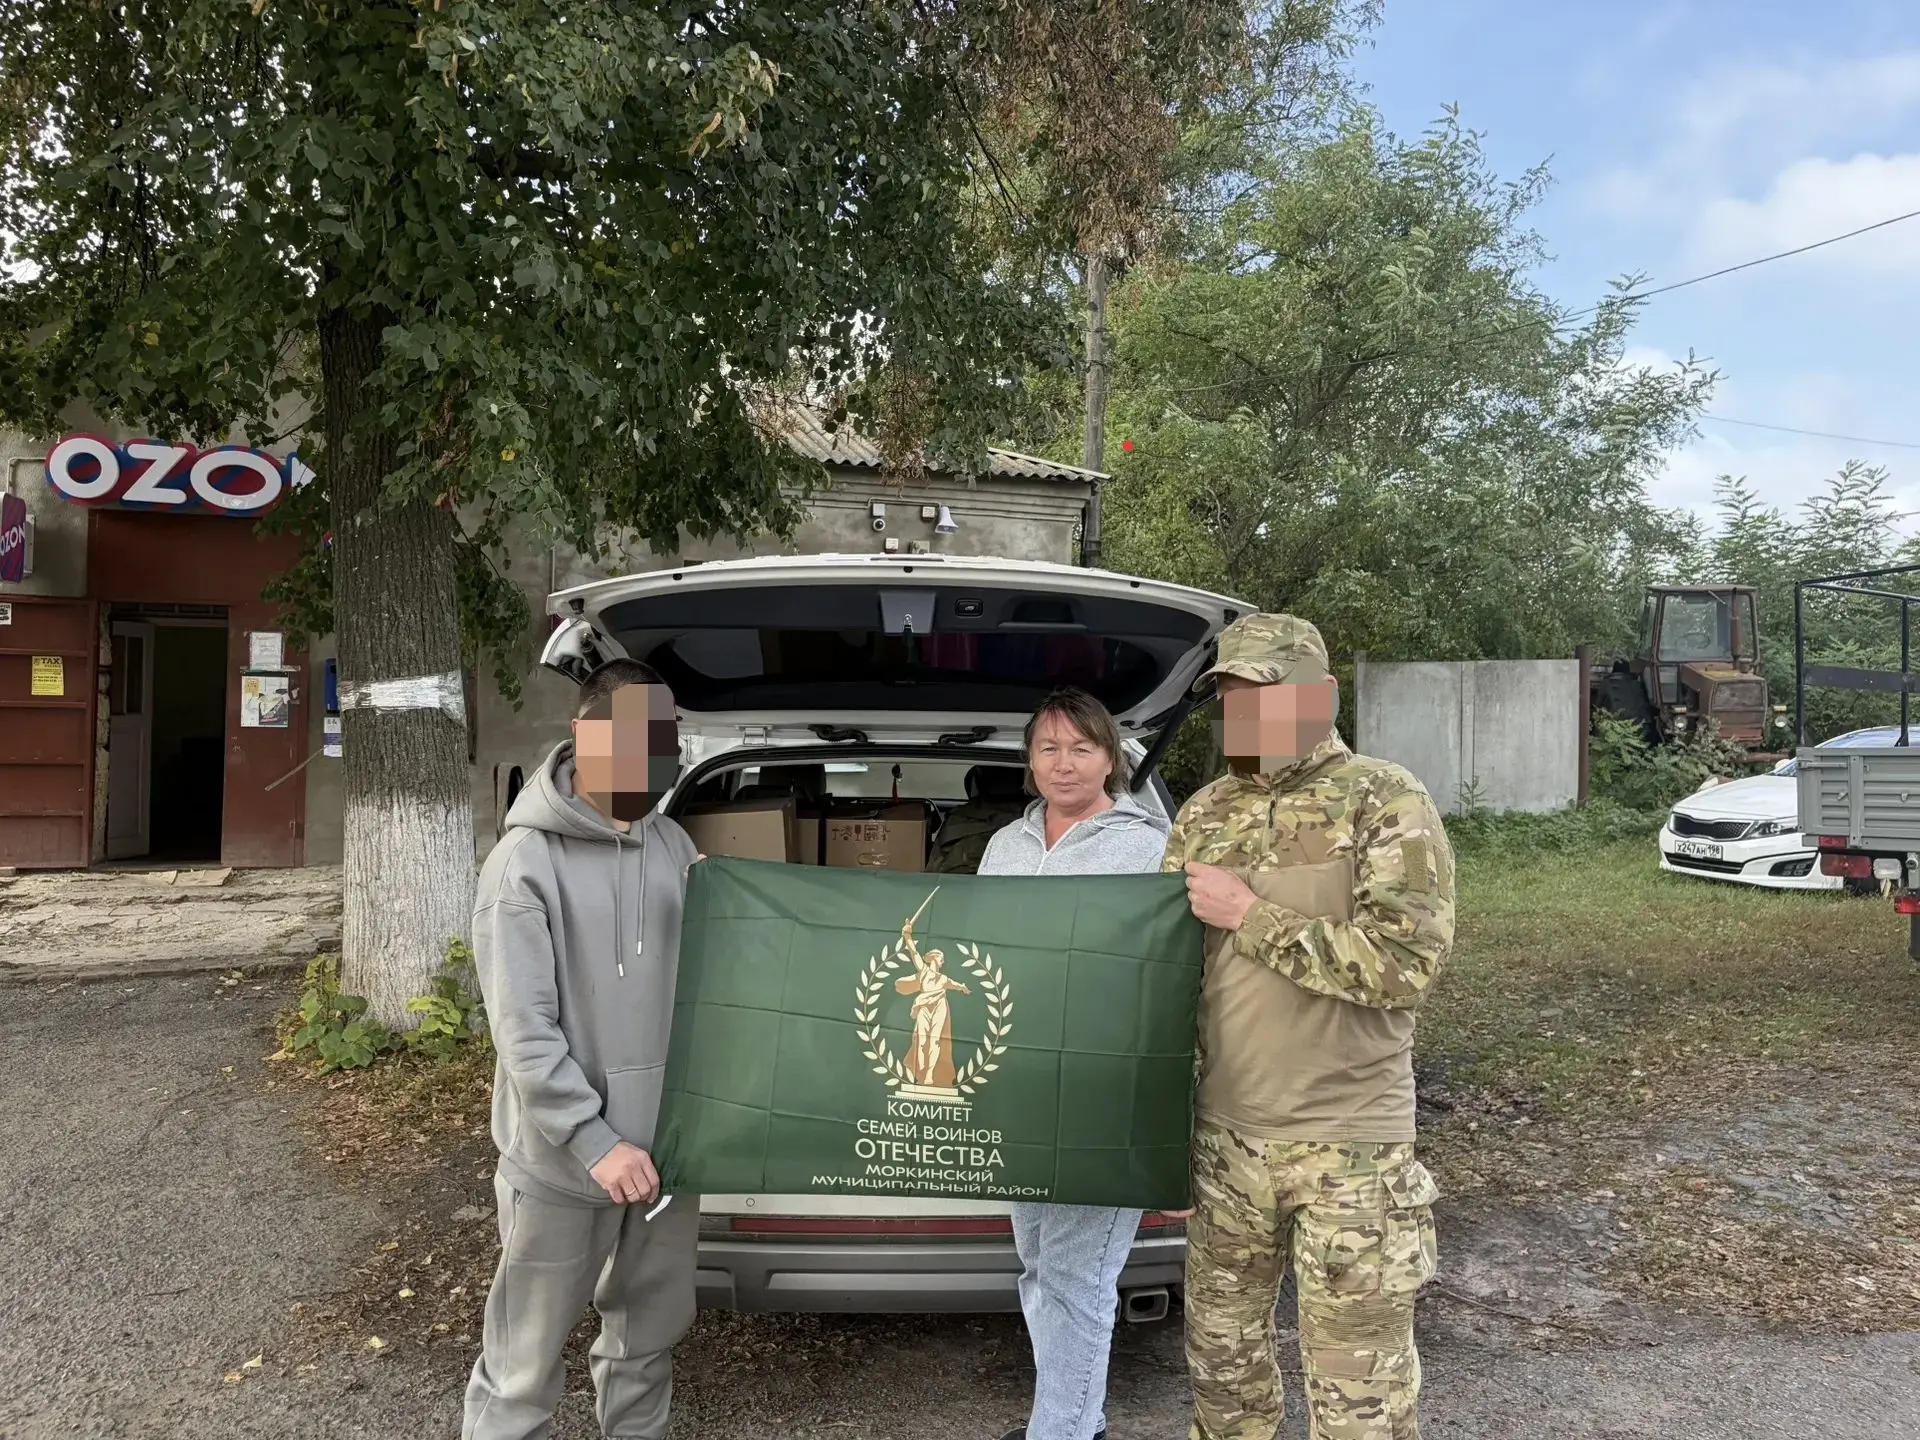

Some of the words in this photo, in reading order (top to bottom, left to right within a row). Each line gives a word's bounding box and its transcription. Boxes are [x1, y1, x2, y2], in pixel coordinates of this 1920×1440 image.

[0, 522, 26, 556] OZON
[887, 1101, 973, 1122] КОМИТЕТ
[856, 1119, 917, 1139] СЕМЕЙ
[923, 1126, 1003, 1144] ВОИНОВ
[854, 1138, 1005, 1167] ОТЕЧЕСТВА
[865, 1164, 994, 1183] МОРКИНСКИЙ
[811, 1175, 981, 1193] МУНИЦИПАЛЬНЫЙ
[987, 1184, 1049, 1196] РАЙОН
